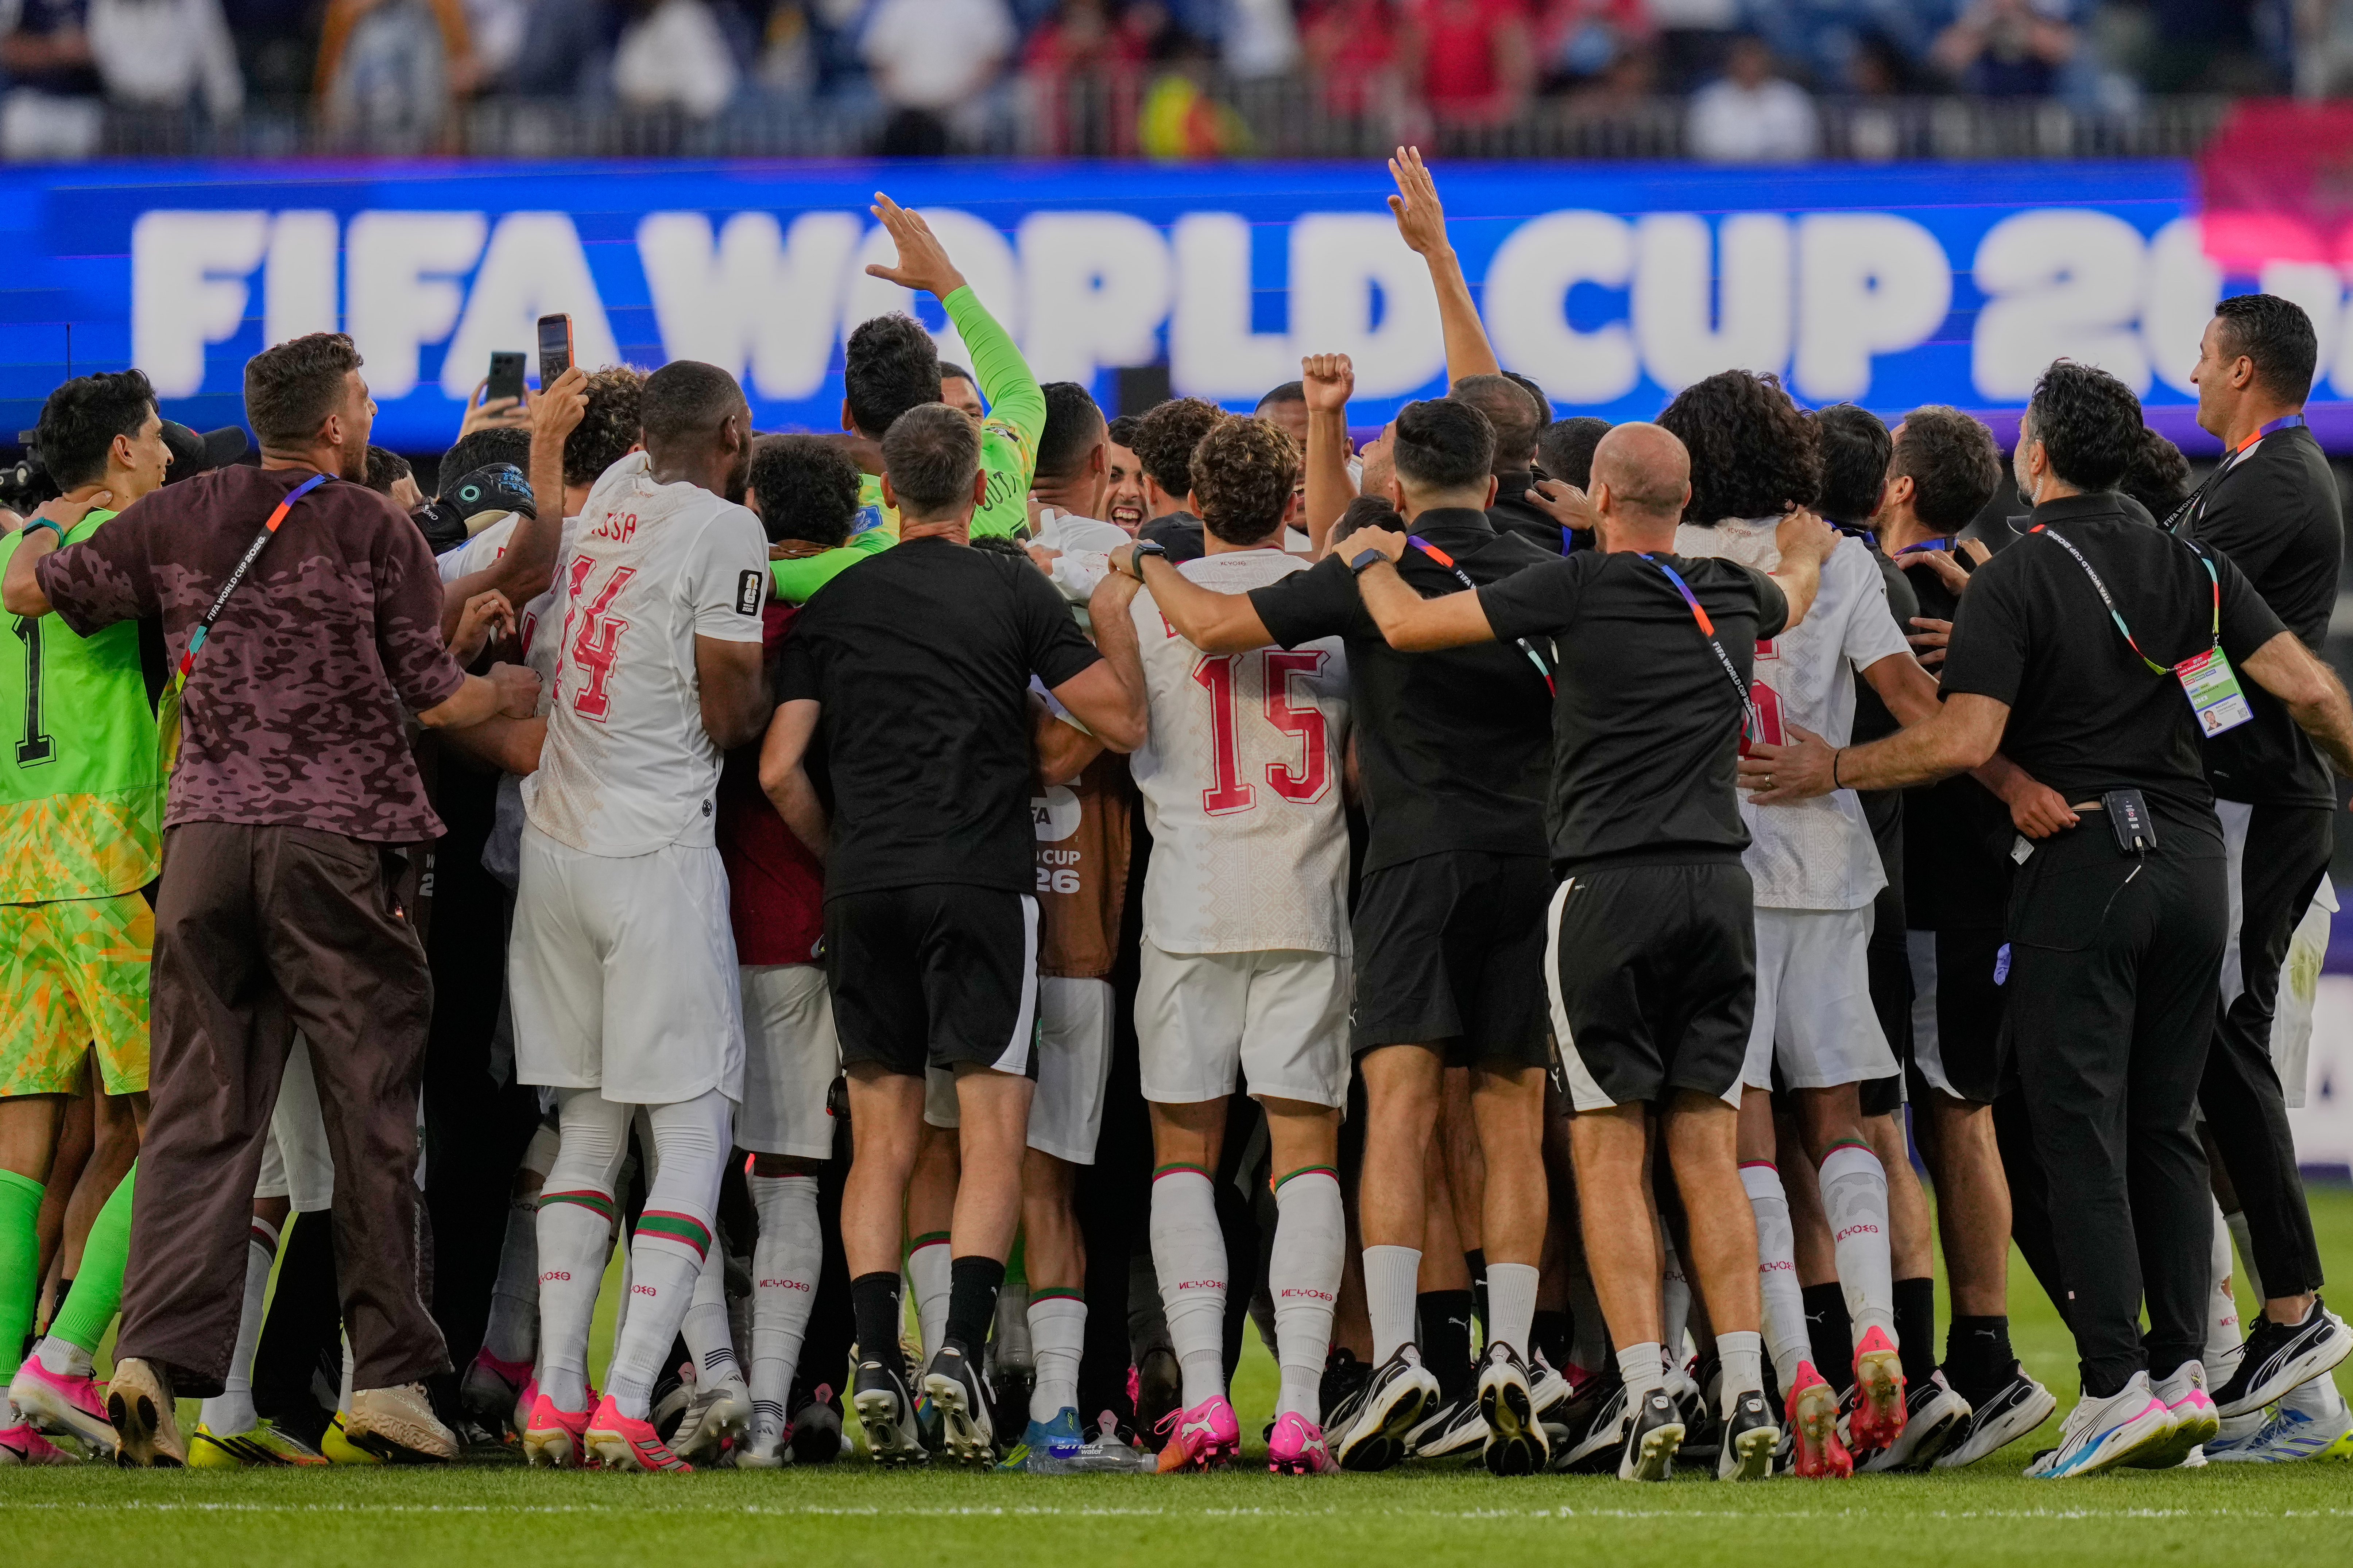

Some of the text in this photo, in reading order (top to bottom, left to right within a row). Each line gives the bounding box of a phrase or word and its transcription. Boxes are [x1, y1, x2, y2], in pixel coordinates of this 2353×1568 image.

[132, 209, 623, 400] FIFA
[636, 208, 1450, 400] WORLD
[1482, 209, 1952, 403] CUP
[2163, 513, 2179, 527] FIFA
[2176, 492, 2199, 513] WORLD
[207, 536, 266, 621] FIFA WORLD CUP 2026
[1456, 569, 1471, 586] FIFA
[2046, 529, 2111, 604] FIFA WORLD CUP 2026
[553, 554, 637, 723] 14
[1712, 641, 1726, 660] FIFA
[1722, 657, 1741, 686] WORLD
[1738, 684, 1747, 697] CUP
[2187, 663, 2201, 671] WORLD
[12, 615, 56, 769] 1
[1192, 650, 1331, 816] 15
[1042, 850, 1081, 865] CUP
